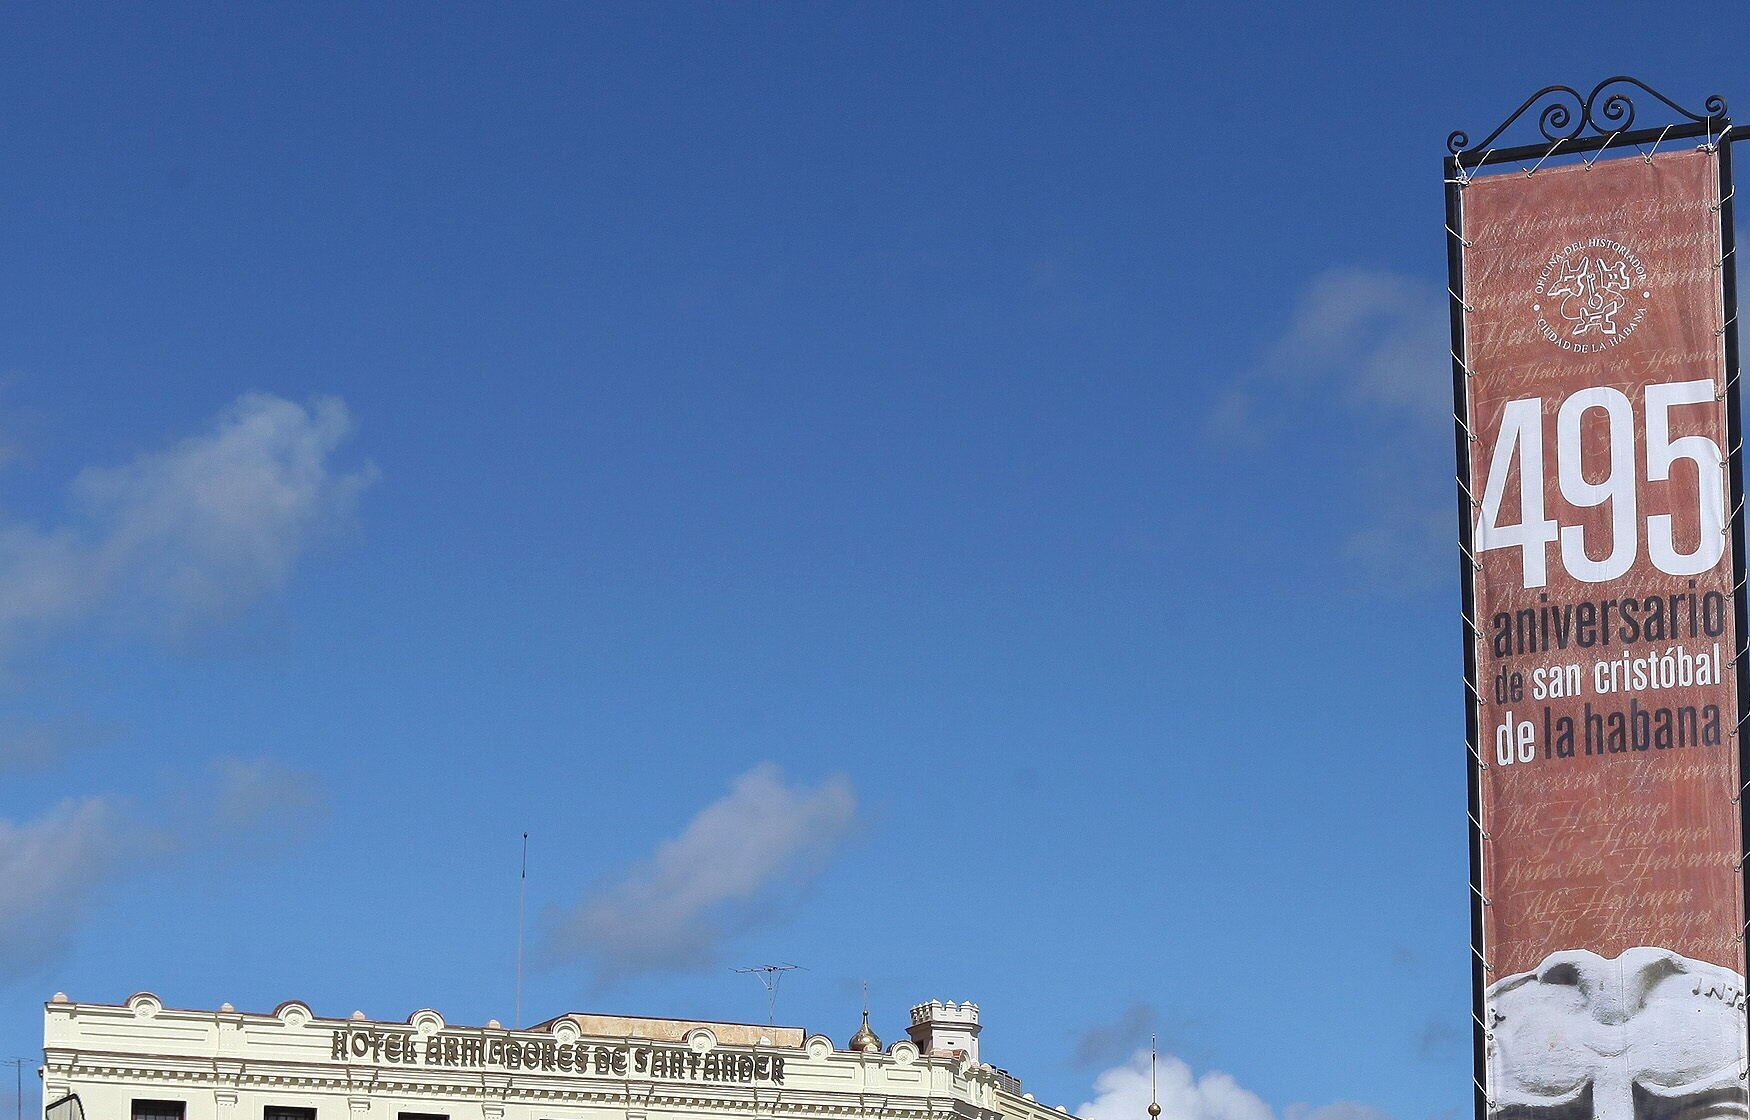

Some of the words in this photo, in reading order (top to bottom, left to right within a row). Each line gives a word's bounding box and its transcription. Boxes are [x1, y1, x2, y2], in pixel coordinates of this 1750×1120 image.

[1535, 252, 1564, 294] OFICINA
[1563, 241, 1586, 256] DEL
[1588, 238, 1648, 282] HISTORIADOR
[1537, 318, 1571, 350] CIUDAD
[1573, 343, 1588, 353] DE
[1591, 343, 1607, 353] LA
[1609, 307, 1648, 347] HABANA
[1475, 378, 1727, 590] 495
[1494, 578, 1725, 658] aniversario
[1495, 664, 1524, 705] de
[1533, 663, 1582, 701] san
[1595, 643, 1722, 695] cristóbal
[1496, 710, 1536, 766] de
[1544, 706, 1576, 760] la
[1584, 698, 1722, 756] habana
[331, 1030, 418, 1065] HOTEL
[424, 1035, 589, 1074] ARMADORES
[595, 1045, 629, 1077] DE
[634, 1047, 786, 1087] SANTANDER
